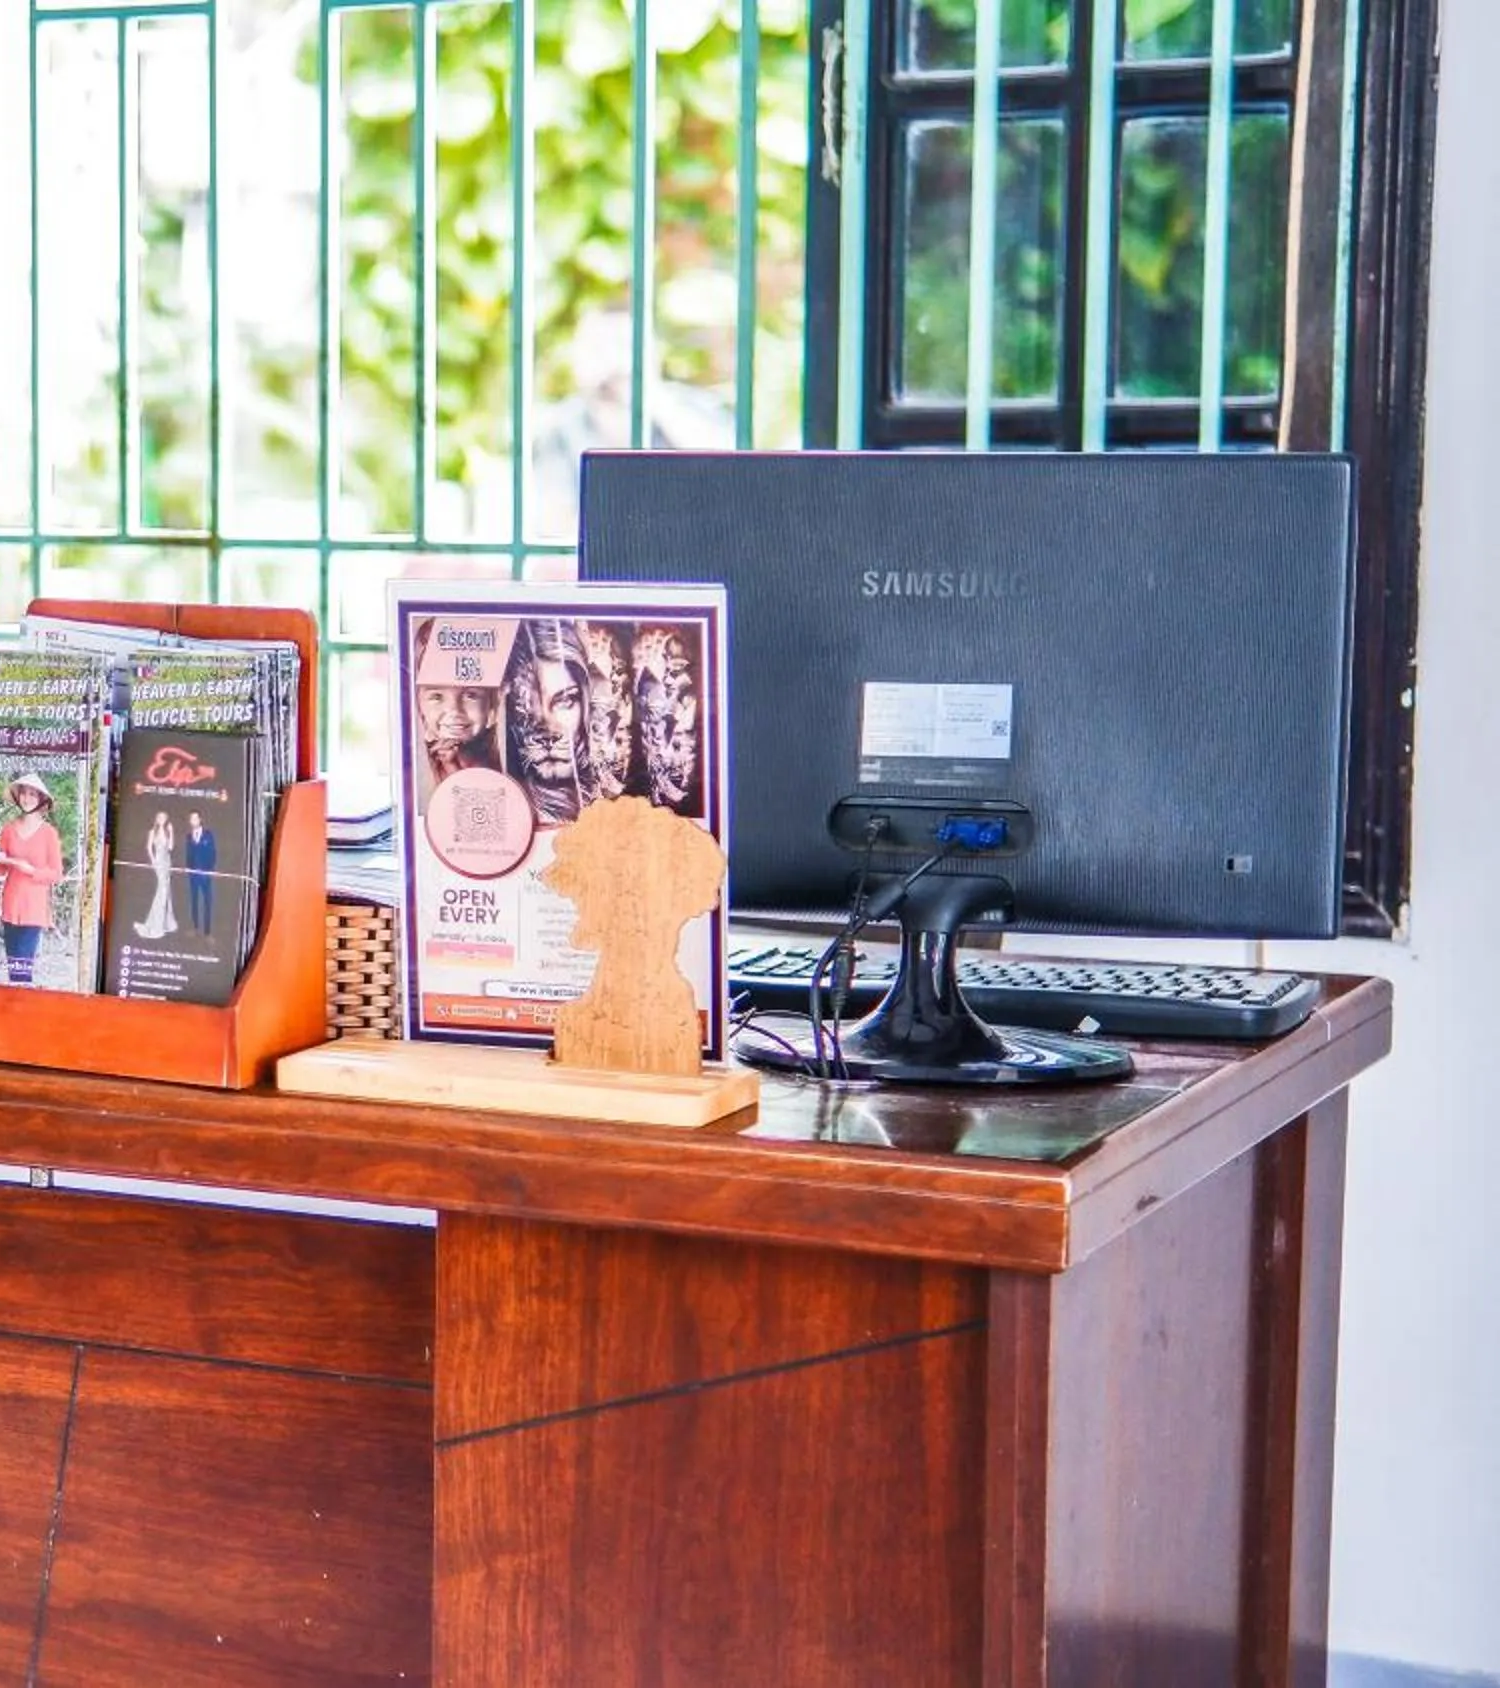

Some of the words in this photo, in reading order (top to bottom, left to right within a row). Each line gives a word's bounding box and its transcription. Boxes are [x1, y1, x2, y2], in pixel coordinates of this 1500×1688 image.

[861, 570, 1030, 597] SAMSUNG
[437, 625, 496, 650] discount
[42, 678, 87, 694] EARTH
[131, 681, 187, 700] HEAVEN
[206, 678, 252, 696] EARTH
[37, 703, 88, 721] TOURS
[133, 707, 198, 727] BICYCLE
[203, 704, 256, 722] TOURS
[443, 888, 496, 906] OPEN
[439, 905, 500, 925] EVERY
